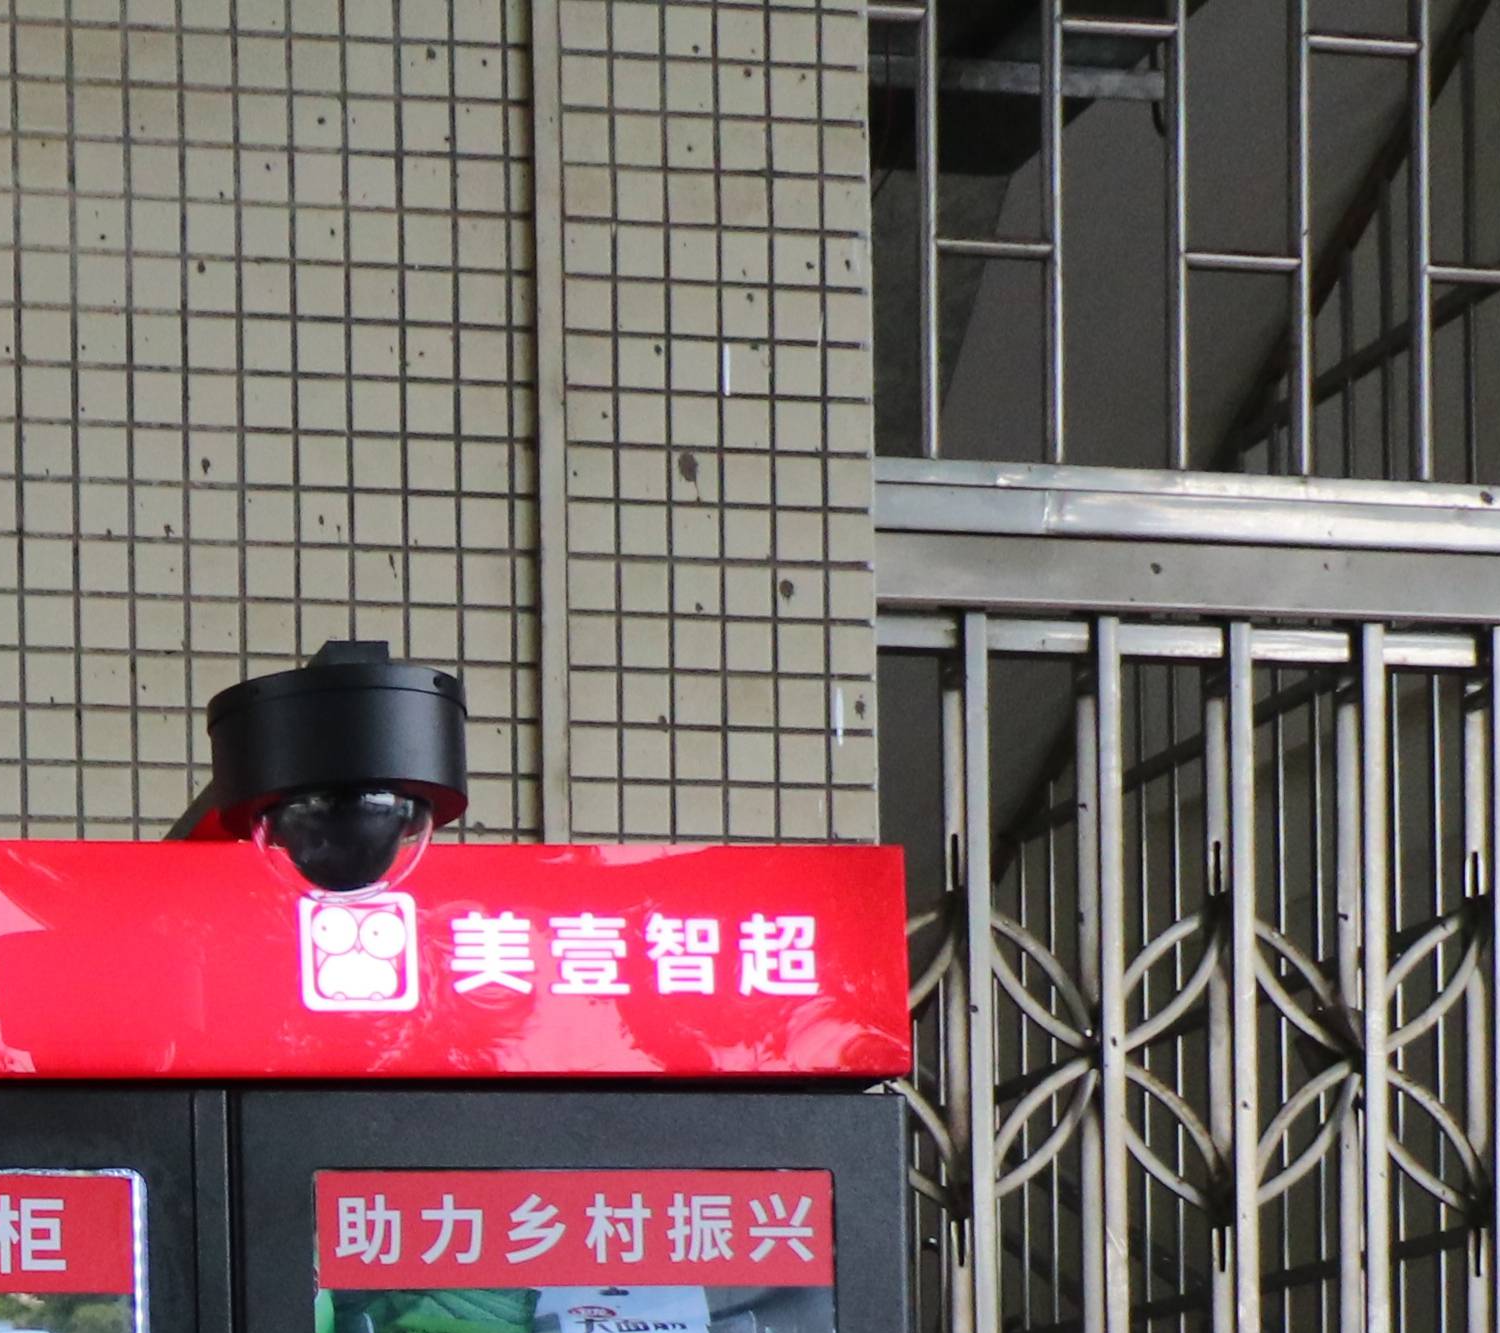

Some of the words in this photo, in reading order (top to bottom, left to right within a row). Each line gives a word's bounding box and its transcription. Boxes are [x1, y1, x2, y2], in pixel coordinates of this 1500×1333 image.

[449, 910, 819, 998] 美壹智超
[335, 1192, 815, 1265] 助力乡村振兴
